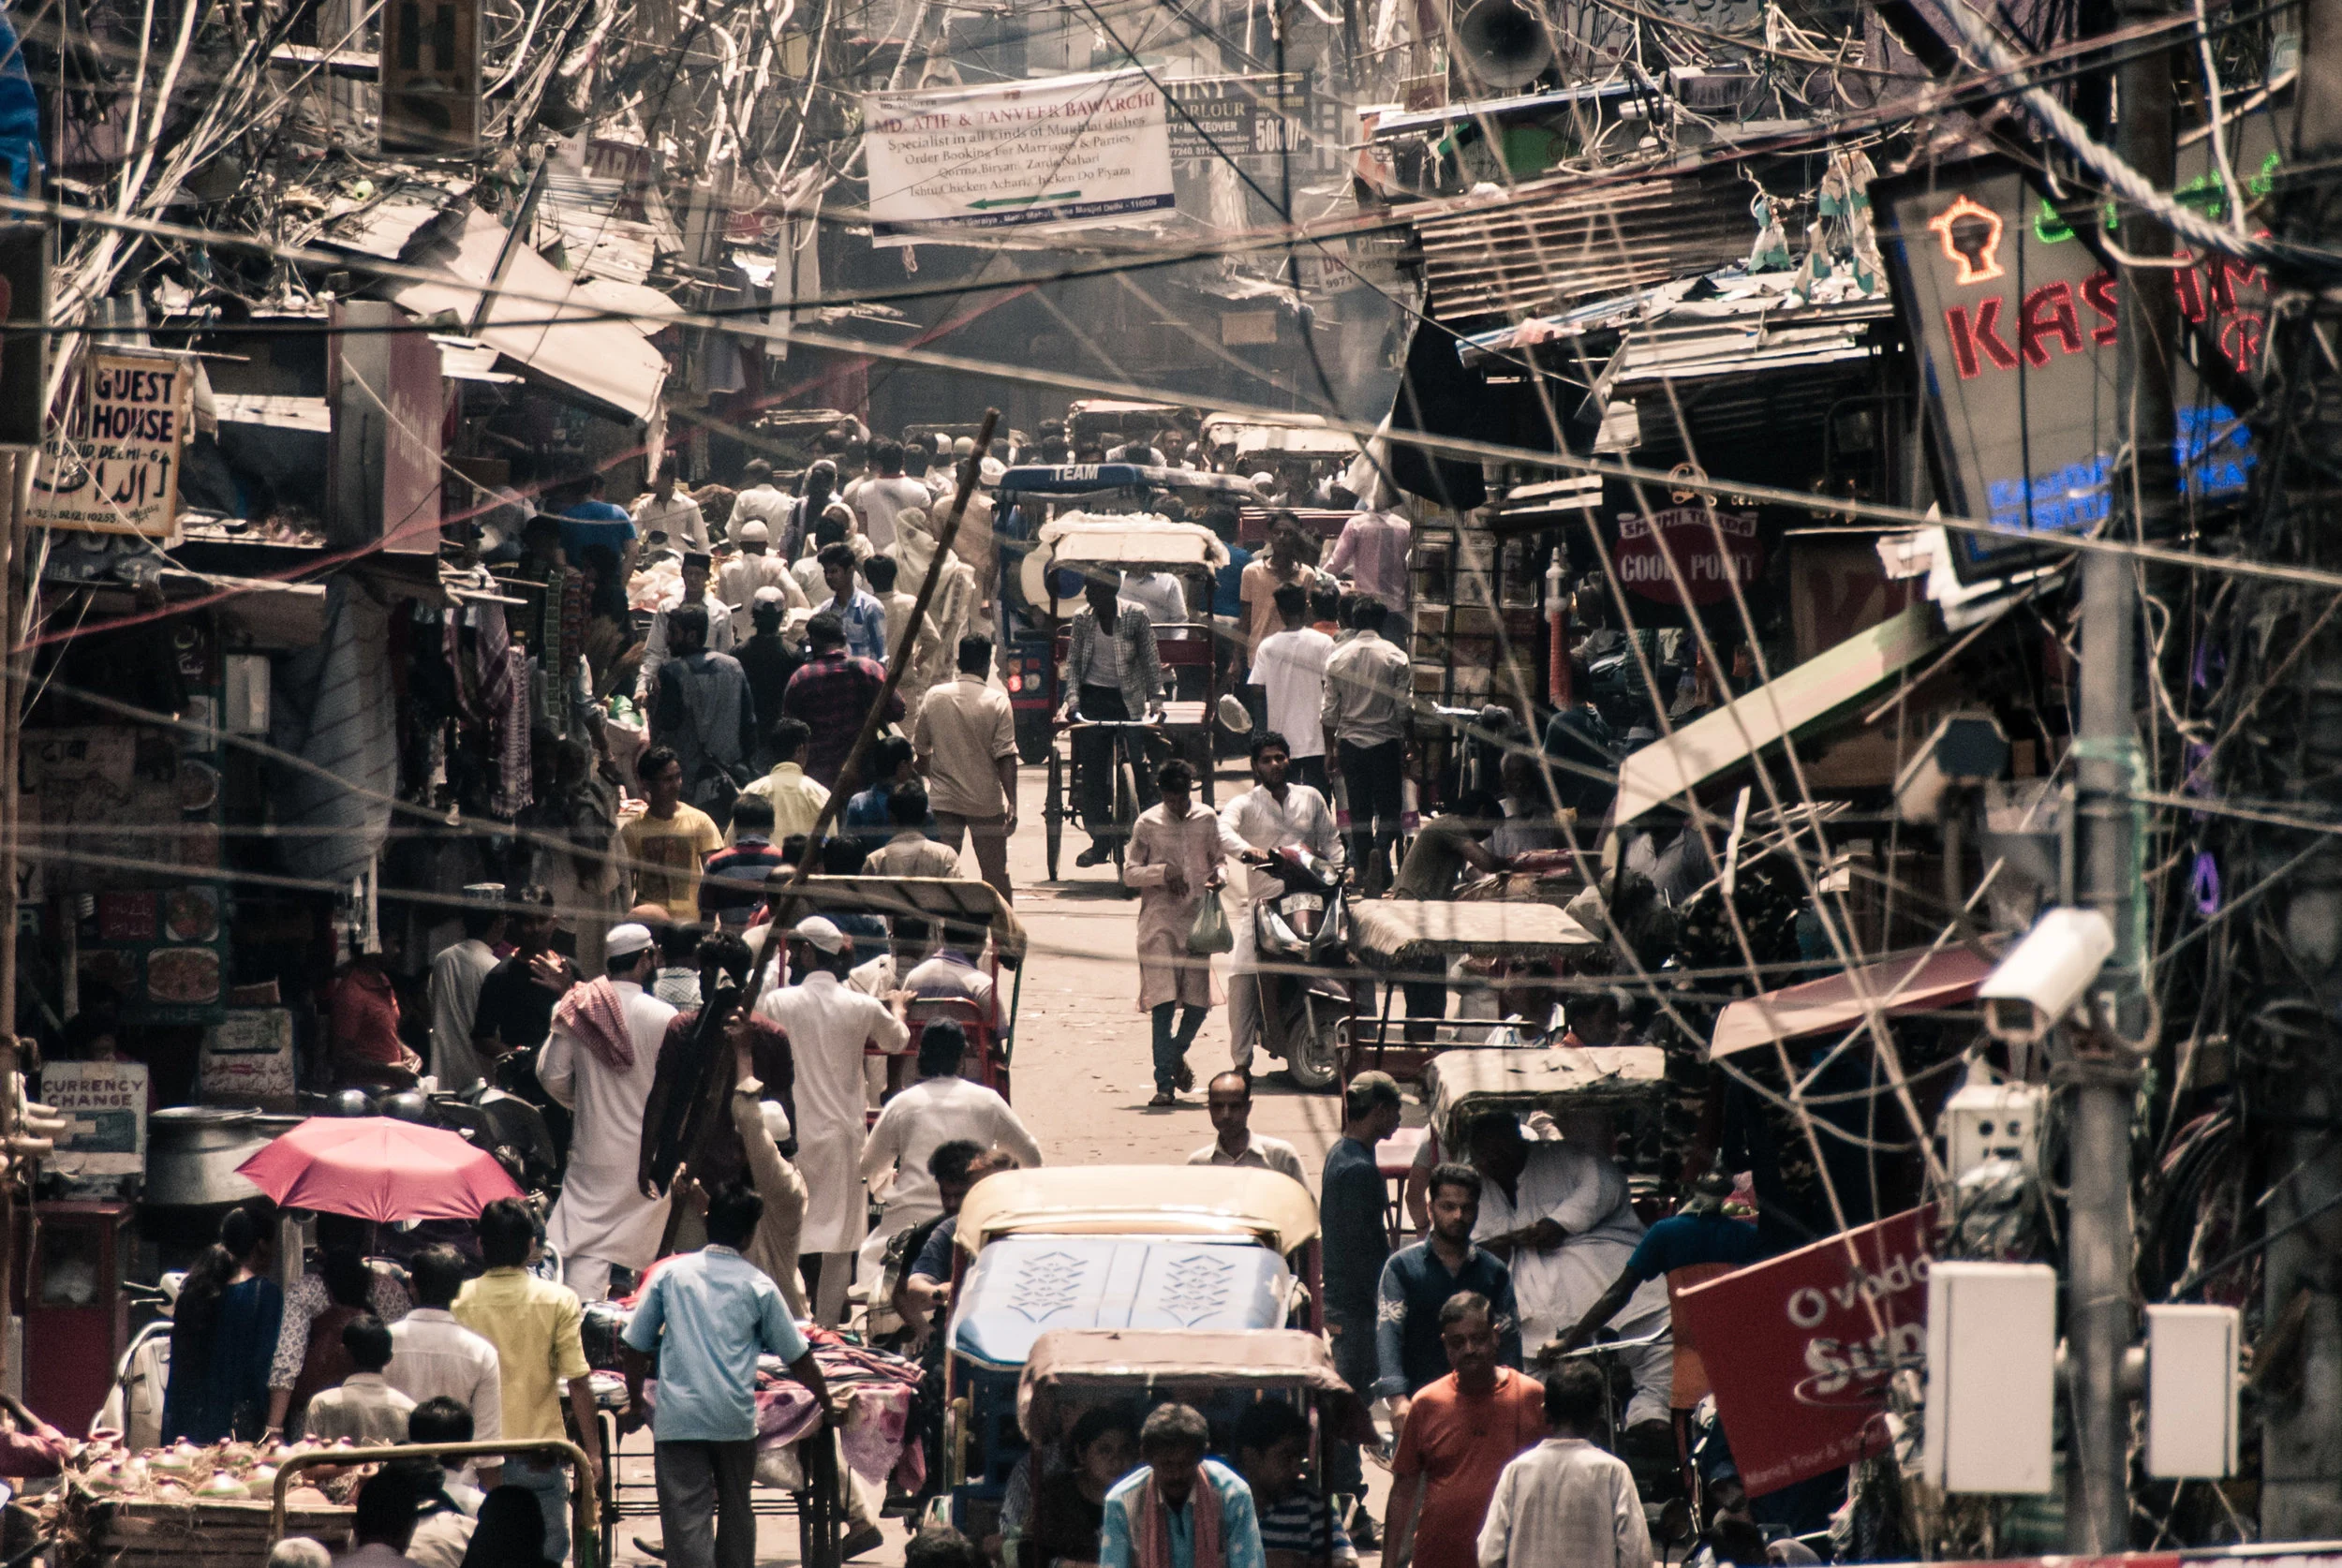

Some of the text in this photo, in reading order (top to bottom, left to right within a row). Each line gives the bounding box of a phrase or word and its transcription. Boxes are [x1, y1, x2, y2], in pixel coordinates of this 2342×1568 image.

[912, 113, 950, 131] ATIF
[958, 113, 971, 127] &
[1065, 92, 1154, 117] BAWARCHI
[888, 135, 950, 153] Specialist
[953, 133, 966, 144] in
[969, 128, 985, 142] all
[1030, 124, 1044, 137] of
[1104, 115, 1146, 130] dishes
[905, 152, 940, 165] Order
[942, 147, 992, 162] Booking
[95, 368, 176, 404] GUEST
[92, 405, 174, 443] HOUSE
[1054, 465, 1100, 481] TEAM
[1624, 510, 1682, 535] SHHI
[42, 1079, 142, 1094] CURRENCY
[48, 1093, 132, 1107] CHANGE
